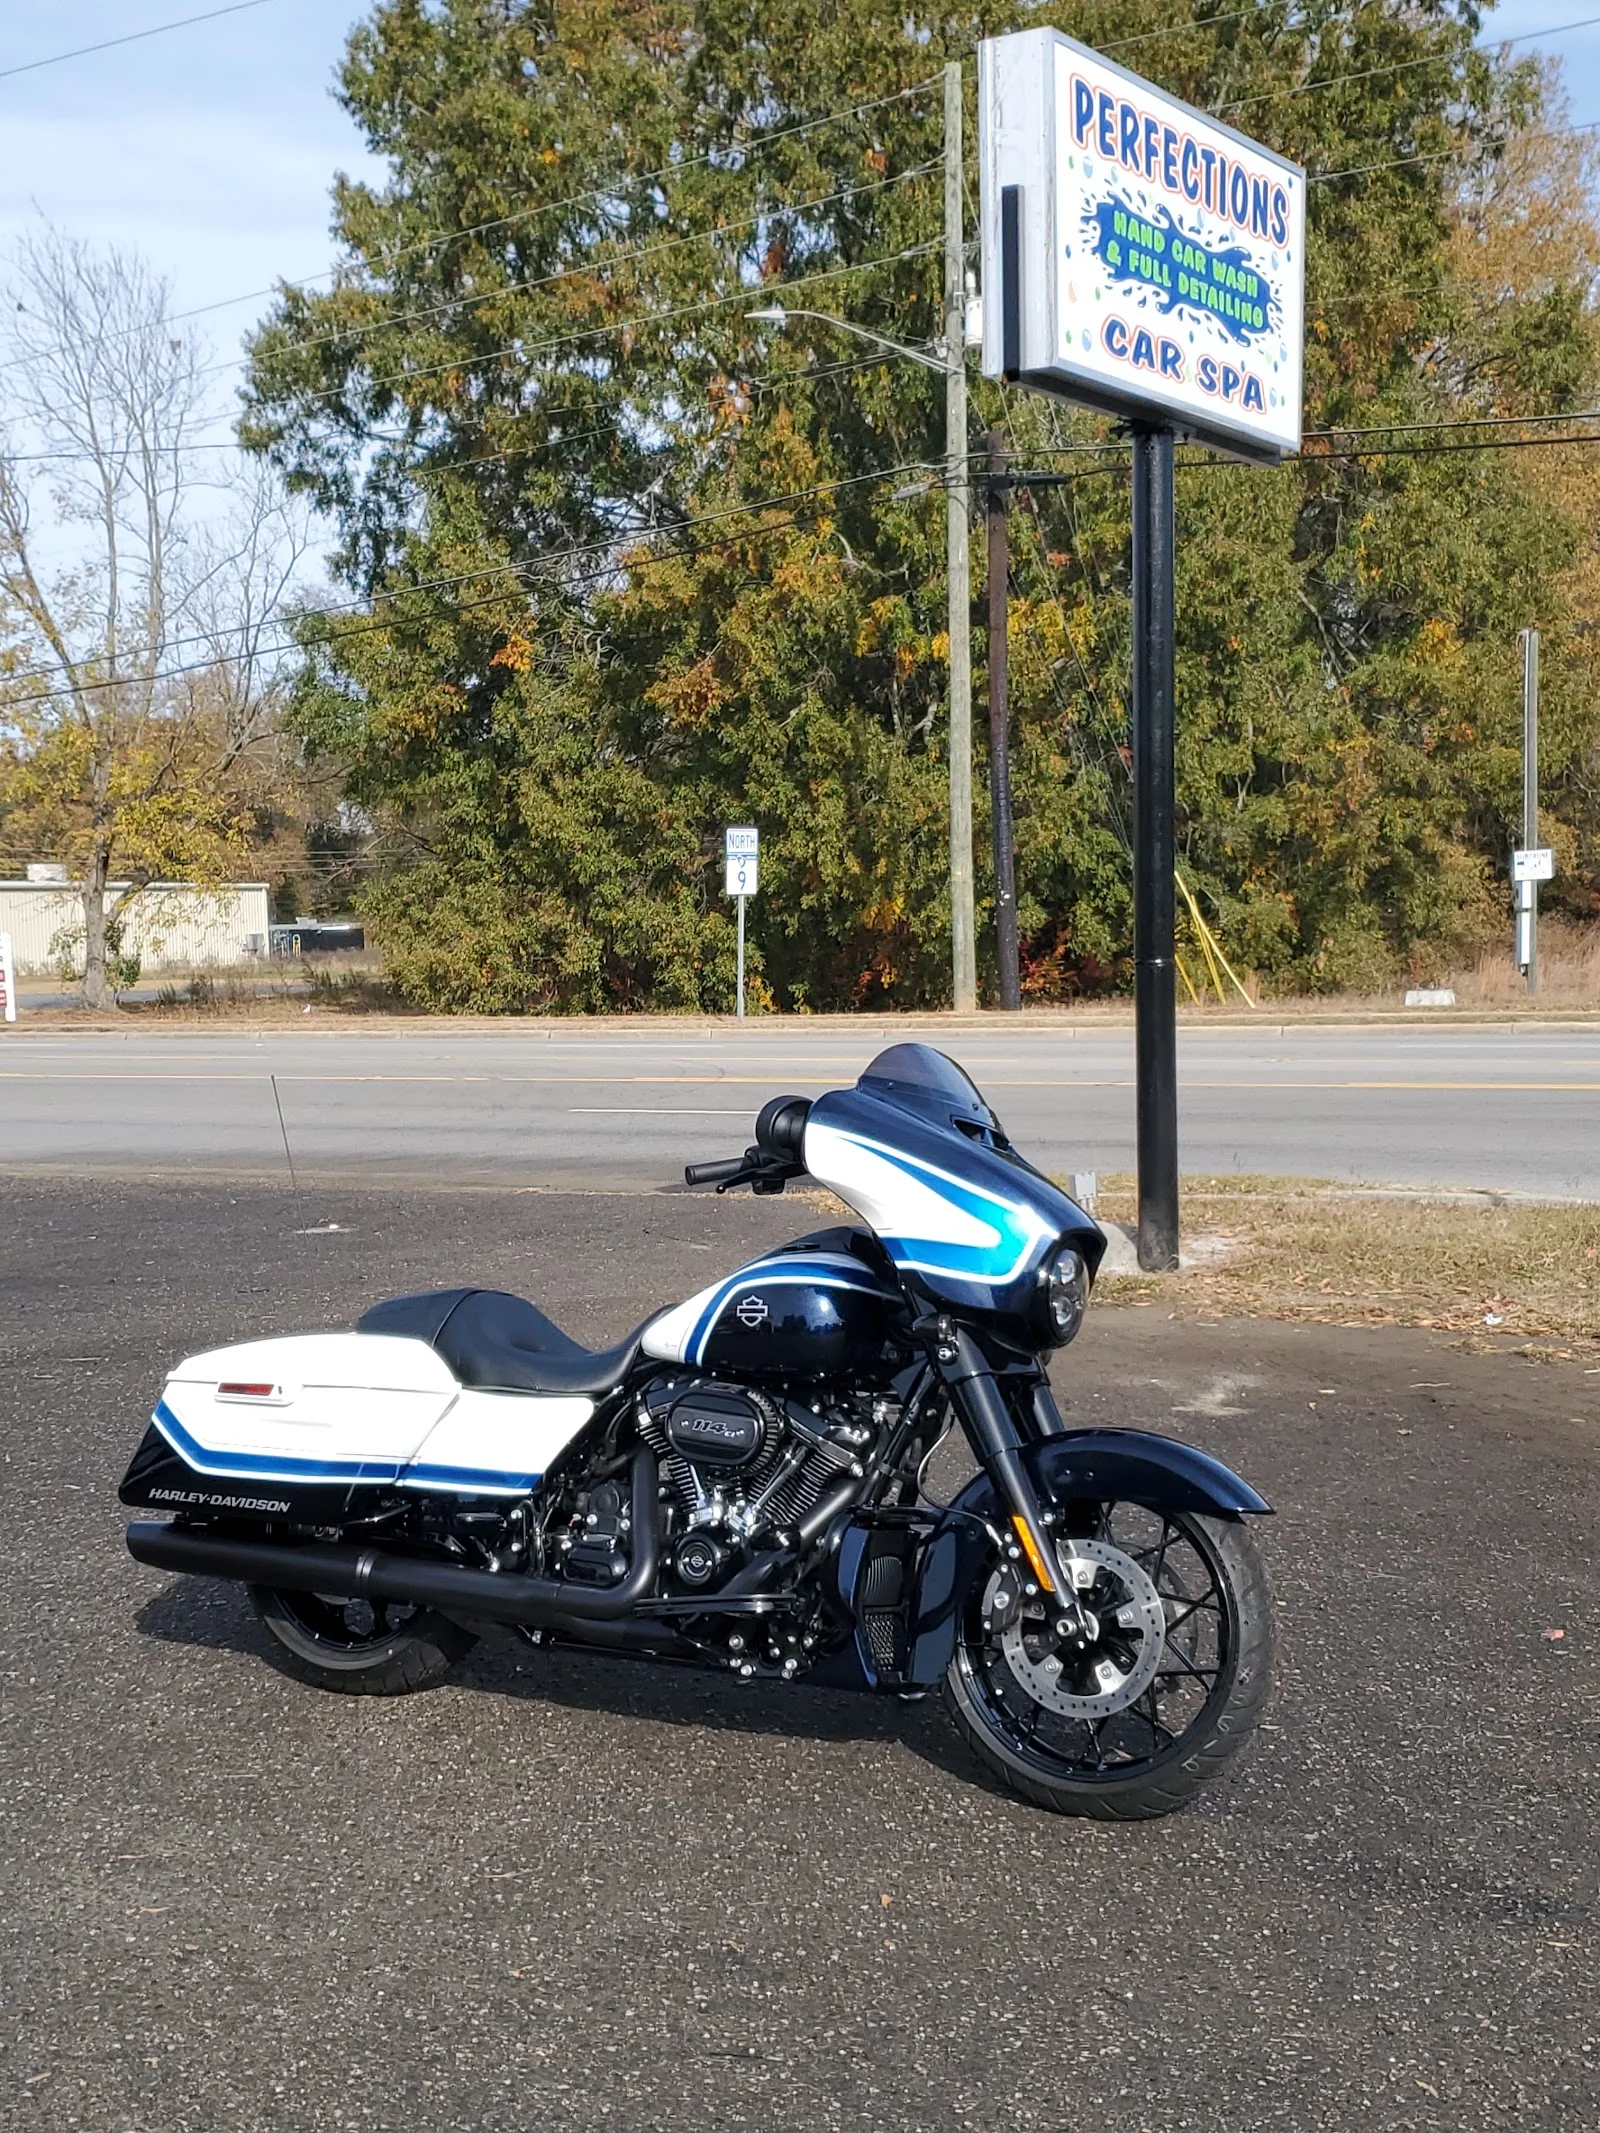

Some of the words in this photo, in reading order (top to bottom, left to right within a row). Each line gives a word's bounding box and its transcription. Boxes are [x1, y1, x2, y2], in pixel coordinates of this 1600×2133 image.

[1072, 76, 1288, 246] PERFECTIONS
[1106, 239, 1122, 267] &
[1128, 248, 1172, 288] FULL
[1177, 271, 1265, 329] DETAILING
[1113, 209, 1166, 254] HAND
[1171, 238, 1207, 276] CAR
[1211, 257, 1259, 299] WASH
[1103, 316, 1183, 382] CAR
[1196, 355, 1265, 412] SPA
[729, 833, 755, 848] NORTH
[738, 871, 746, 891] 9
[692, 1419, 727, 1434] 114
